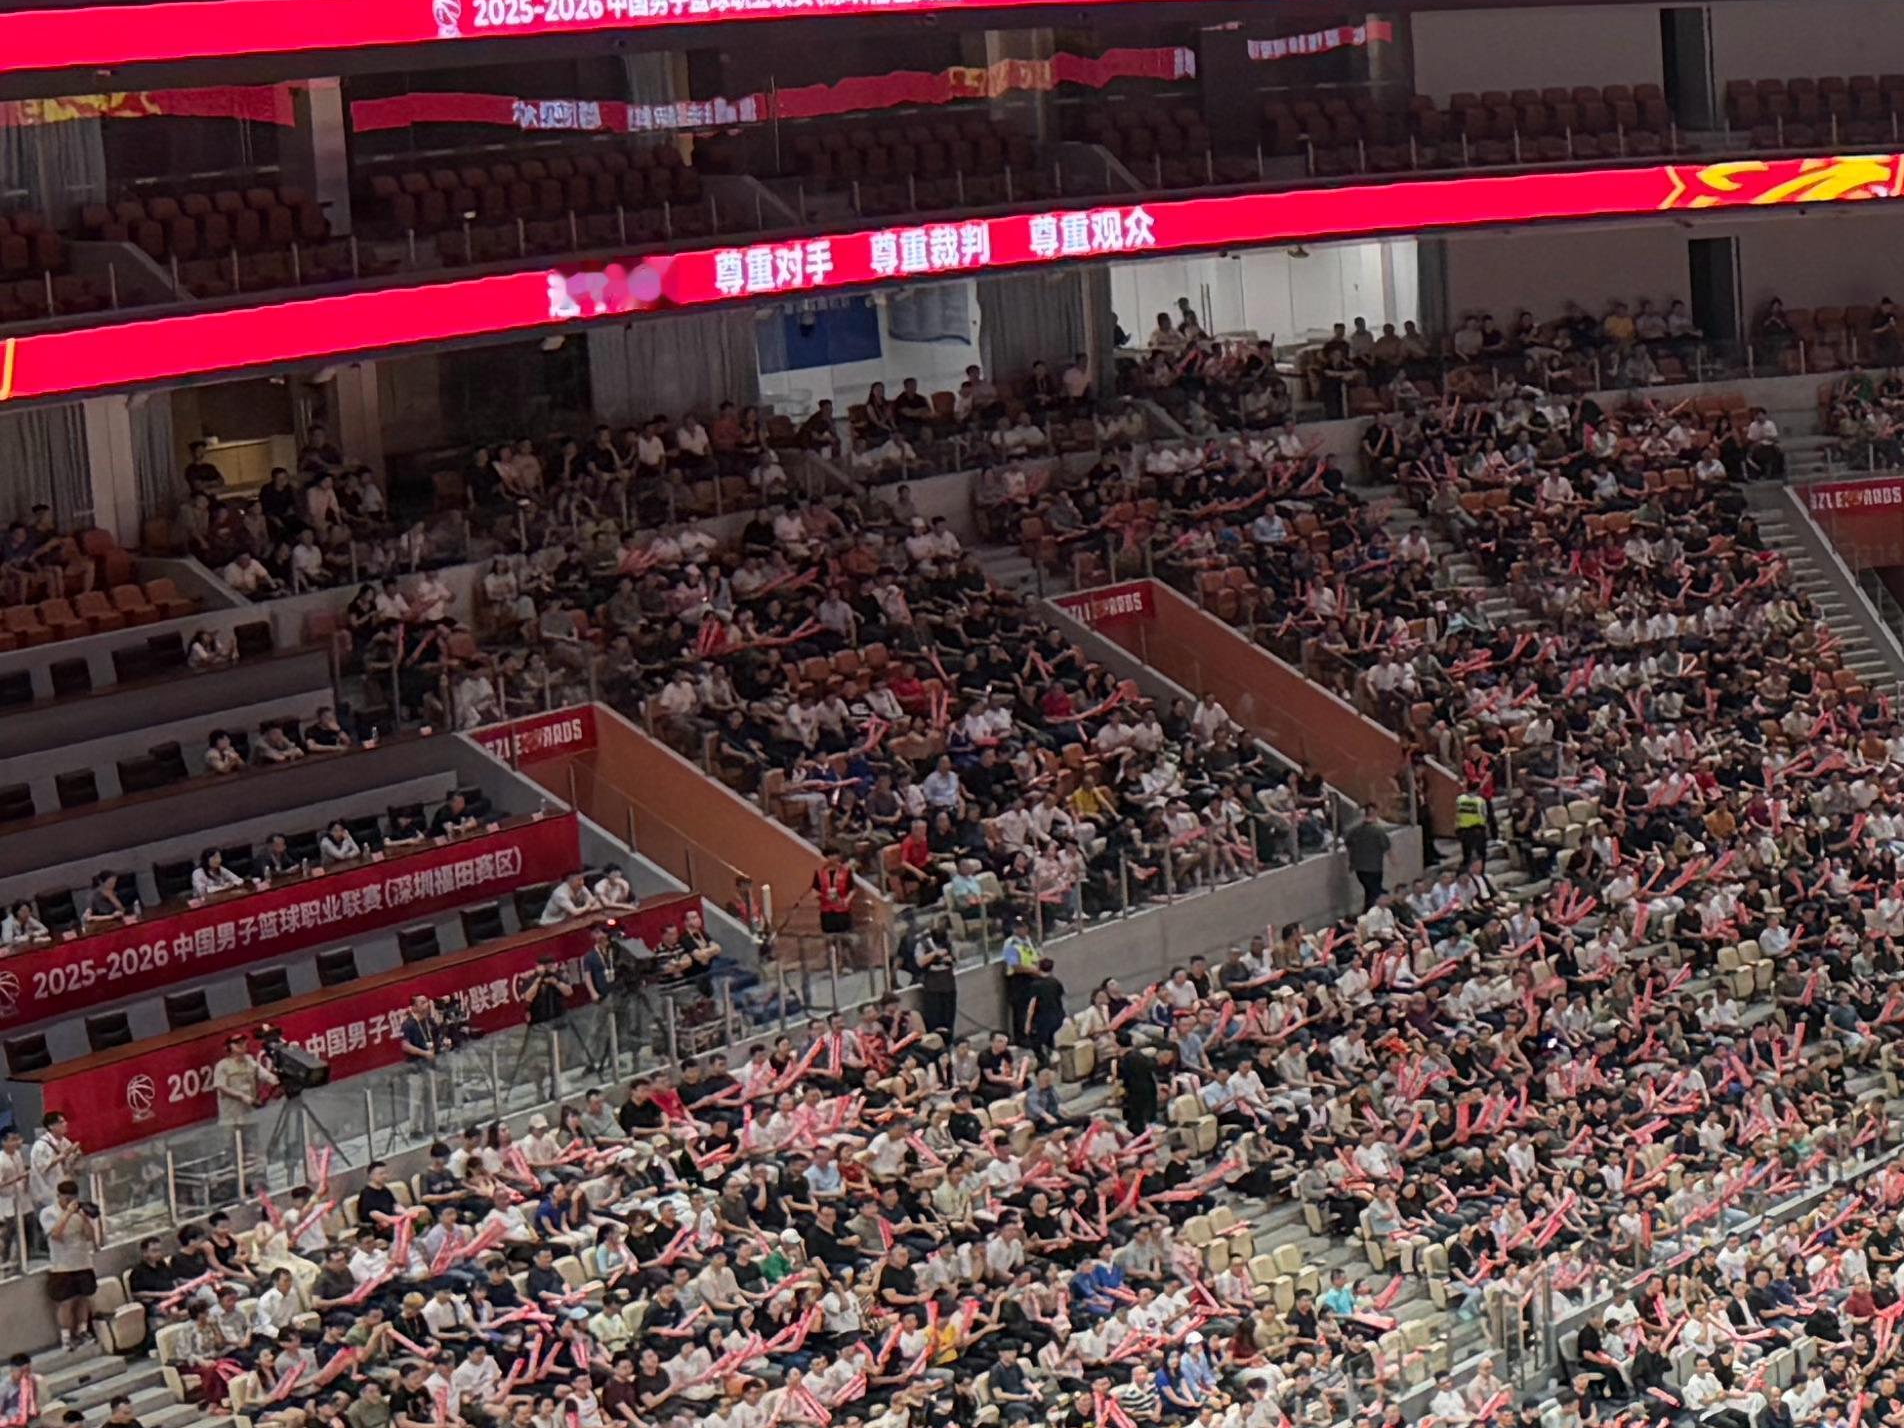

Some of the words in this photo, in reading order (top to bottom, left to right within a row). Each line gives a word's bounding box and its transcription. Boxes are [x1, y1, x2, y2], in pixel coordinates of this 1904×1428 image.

[716, 241, 833, 295] 尊重对手
[871, 222, 990, 275] 尊重裁判
[1030, 206, 1155, 257] 尊重观众
[34, 944, 170, 1000] 2025-2026
[173, 847, 523, 960] 中国男子篮球职业联赛(深圳福田赛区)
